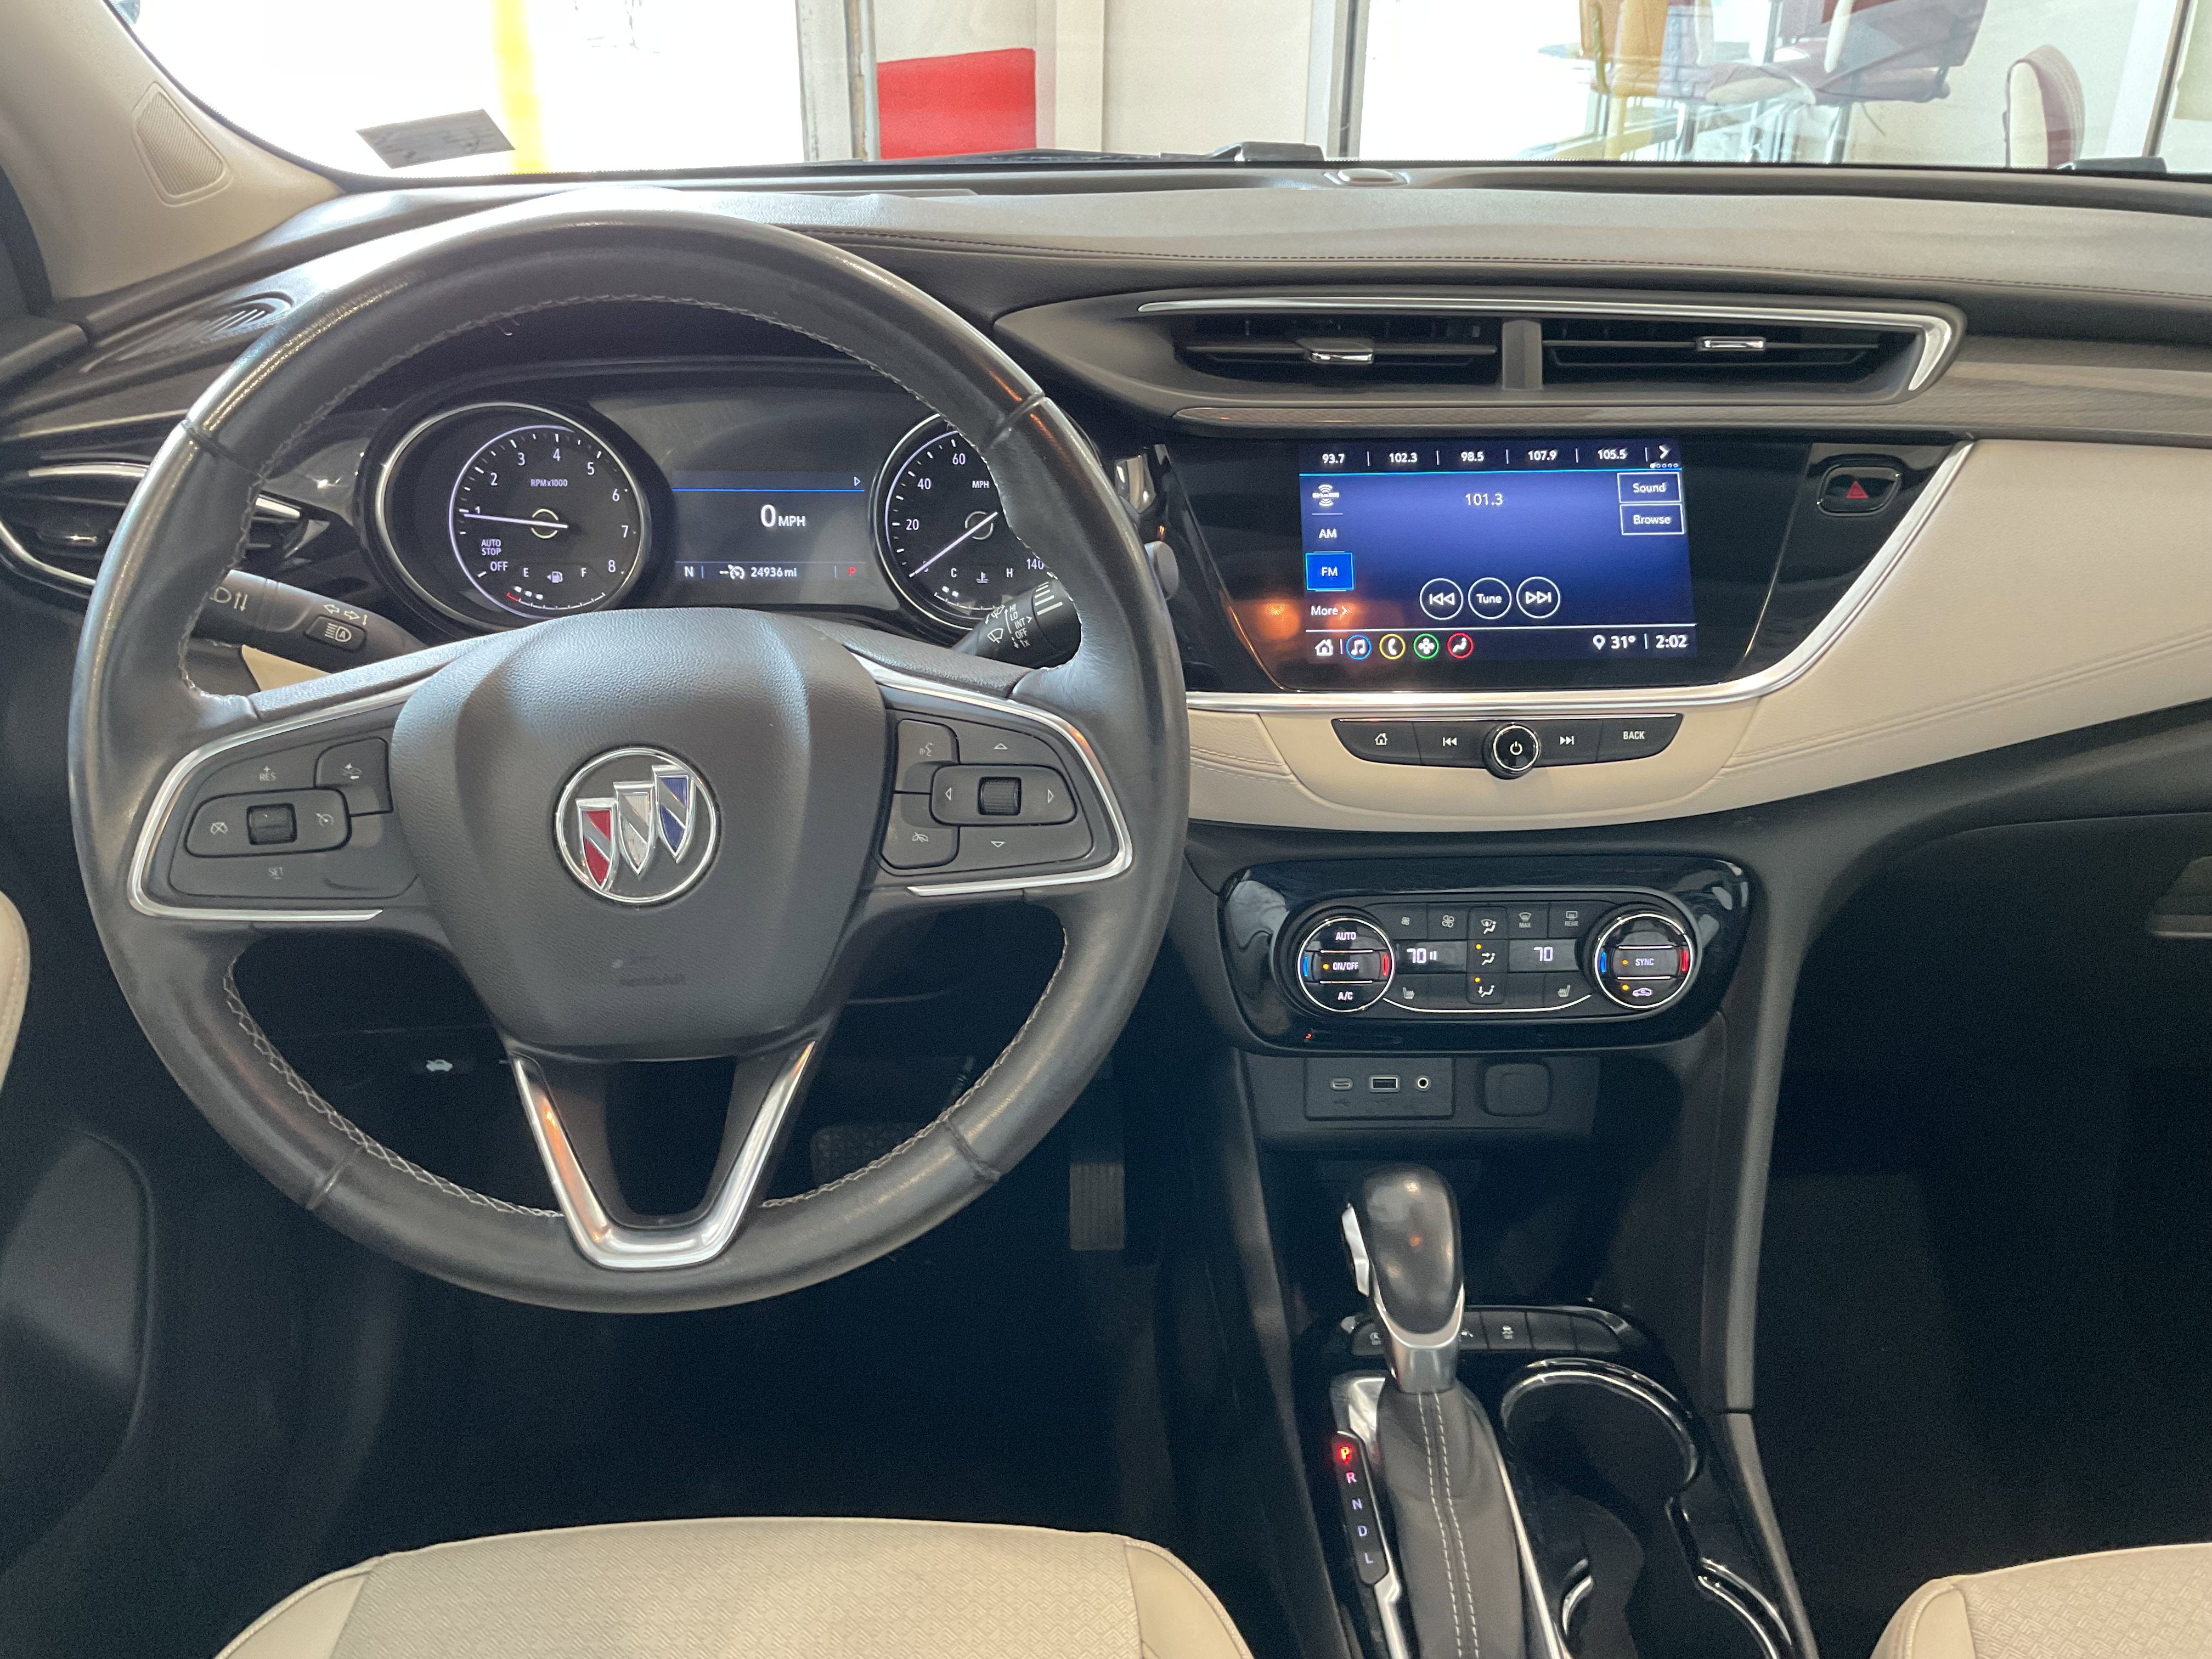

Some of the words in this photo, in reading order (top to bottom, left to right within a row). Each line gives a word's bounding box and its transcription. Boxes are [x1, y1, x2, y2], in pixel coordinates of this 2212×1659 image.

[518, 452, 526, 466] 3
[552, 448, 561, 461] 4
[952, 453, 966, 465] 60
[1322, 453, 1345, 464] 93.7
[1389, 452, 1418, 463] 102.3
[1461, 451, 1485, 462] 98.5
[1528, 450, 1558, 461] 107.9
[1598, 448, 1628, 460] 105.5
[587, 461, 595, 475] 5
[490, 472, 498, 486] 2
[917, 478, 932, 490] 40
[972, 480, 989, 488] MPH
[1633, 482, 1667, 494] Sound
[612, 488, 620, 502] 6
[1465, 493, 1504, 506] 101.3
[760, 504, 777, 528] 0
[778, 515, 806, 527] MPH
[1633, 514, 1671, 525] Browse
[906, 518, 919, 531] 20
[621, 524, 629, 538] 7
[1318, 528, 1338, 539] AM
[481, 539, 501, 548] AUTO
[481, 547, 501, 556] STOP
[490, 561, 508, 572] OFF
[608, 560, 616, 573] 8
[1026, 558, 1045, 570] 140
[523, 567, 529, 578] E
[581, 567, 586, 577] F
[684, 566, 694, 577] N
[751, 567, 783, 577] 24936
[848, 566, 856, 577] P
[951, 567, 957, 578] C
[1006, 568, 1013, 578] H
[1321, 567, 1339, 577] FM
[1476, 593, 1502, 604] Tune
[1009, 603, 1017, 613] HI
[1311, 605, 1339, 616] More
[1010, 611, 1018, 621] LO
[1014, 617, 1026, 629] INT
[1014, 627, 1027, 640] OFF
[1611, 635, 1637, 650] 31°
[1655, 634, 1688, 648] 2:02
[1623, 731, 1645, 740] BACK
[1335, 932, 1357, 941] AUTO
[1406, 947, 1427, 964] 70
[1533, 946, 1554, 962] 70
[1333, 961, 1359, 971] ON/OFF
[1635, 958, 1655, 966] SYNC
[1338, 991, 1353, 1001] A/C
[1340, 1446, 1351, 1460] P
[1346, 1472, 1357, 1484] R
[1352, 1498, 1363, 1510] N
[1357, 1525, 1368, 1537] D
[1364, 1553, 1374, 1564] L
